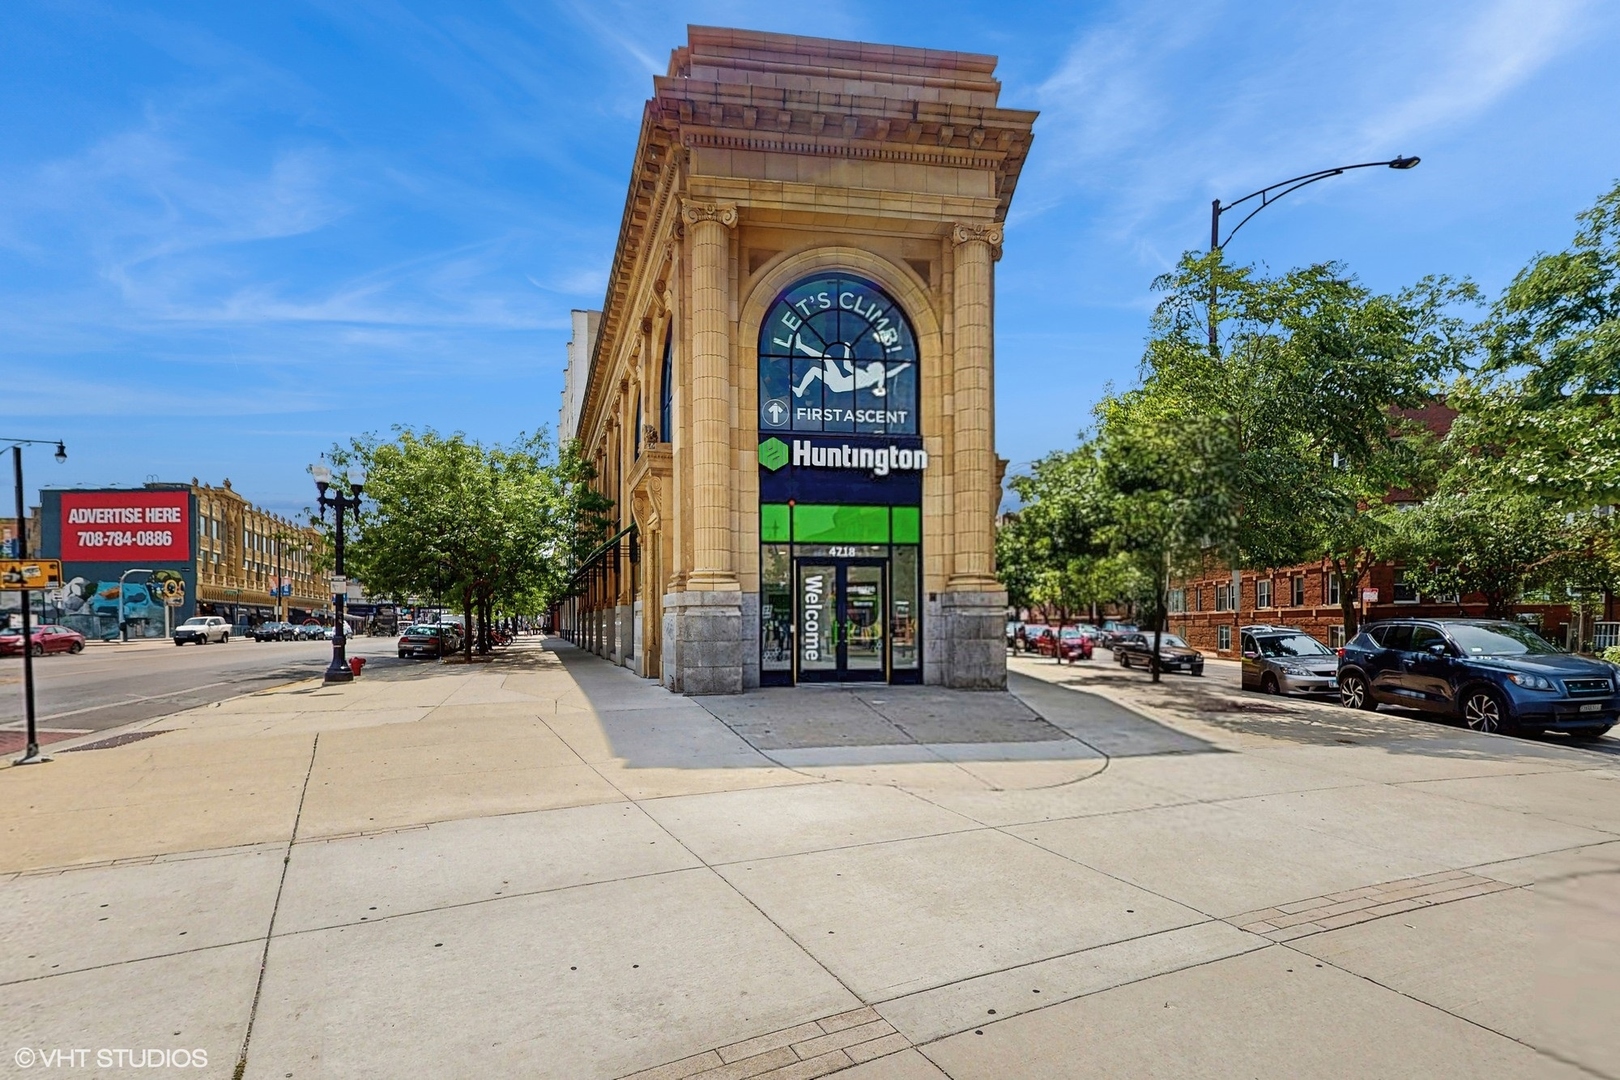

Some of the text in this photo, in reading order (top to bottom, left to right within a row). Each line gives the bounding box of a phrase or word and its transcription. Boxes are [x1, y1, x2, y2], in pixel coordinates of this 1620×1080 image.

[773, 291, 902, 353] LET'S CLIMB!
[796, 408, 907, 424] FIRST ASCENT
[793, 440, 928, 475] Huntington
[68, 507, 181, 524] ADVERTISE HERE
[77, 531, 172, 547] 708-784-0886
[828, 546, 855, 557] 4218
[804, 575, 823, 661] Welcome
